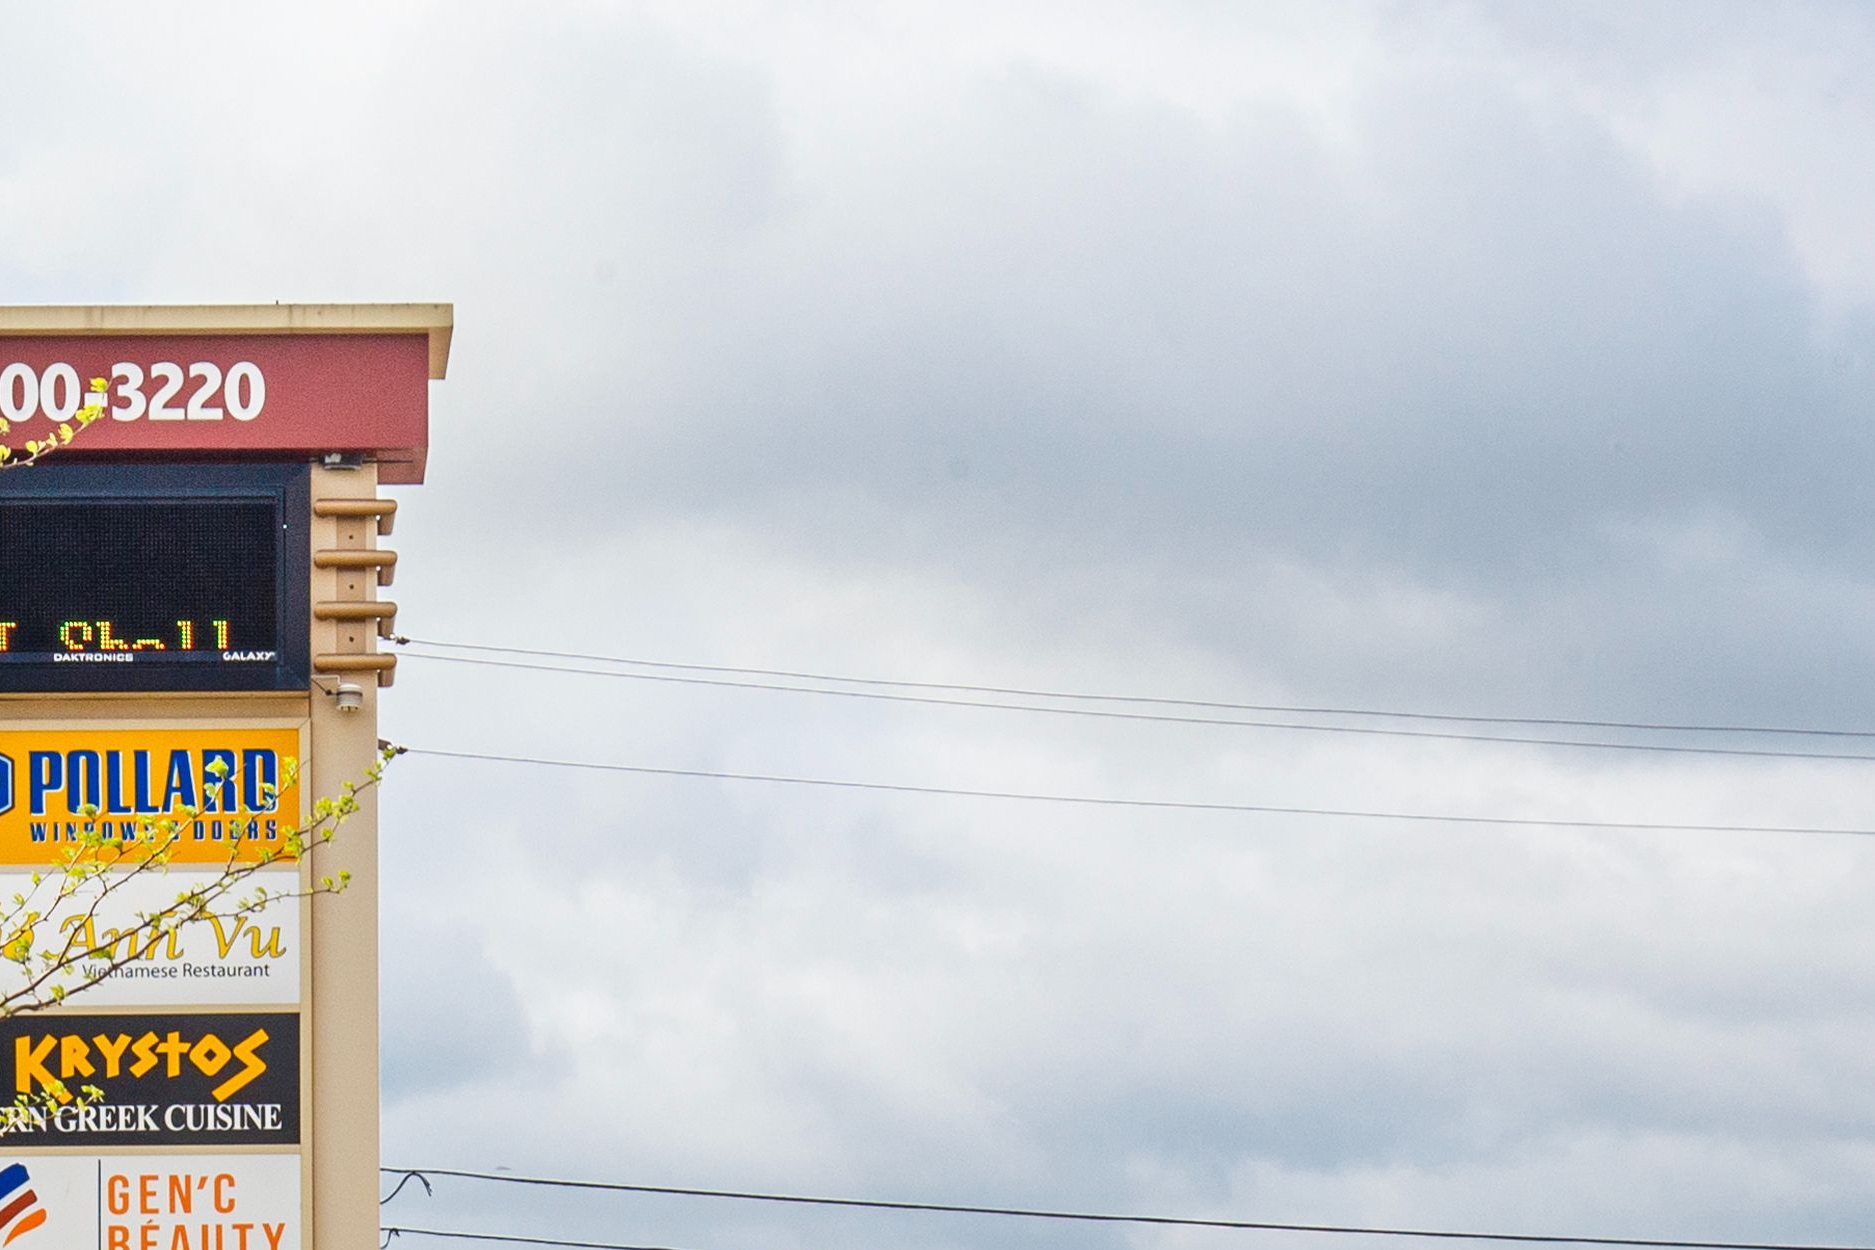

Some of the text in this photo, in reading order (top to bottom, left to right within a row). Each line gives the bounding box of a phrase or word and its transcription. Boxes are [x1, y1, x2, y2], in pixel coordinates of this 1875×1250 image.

[53, 652, 134, 662] DAKTRONICS
[28, 748, 279, 816] POLLARD
[82, 962, 270, 979] Vietnamese Restaurant
[54, 1104, 160, 1132] GREEK
[164, 1104, 283, 1131] CUISINE
